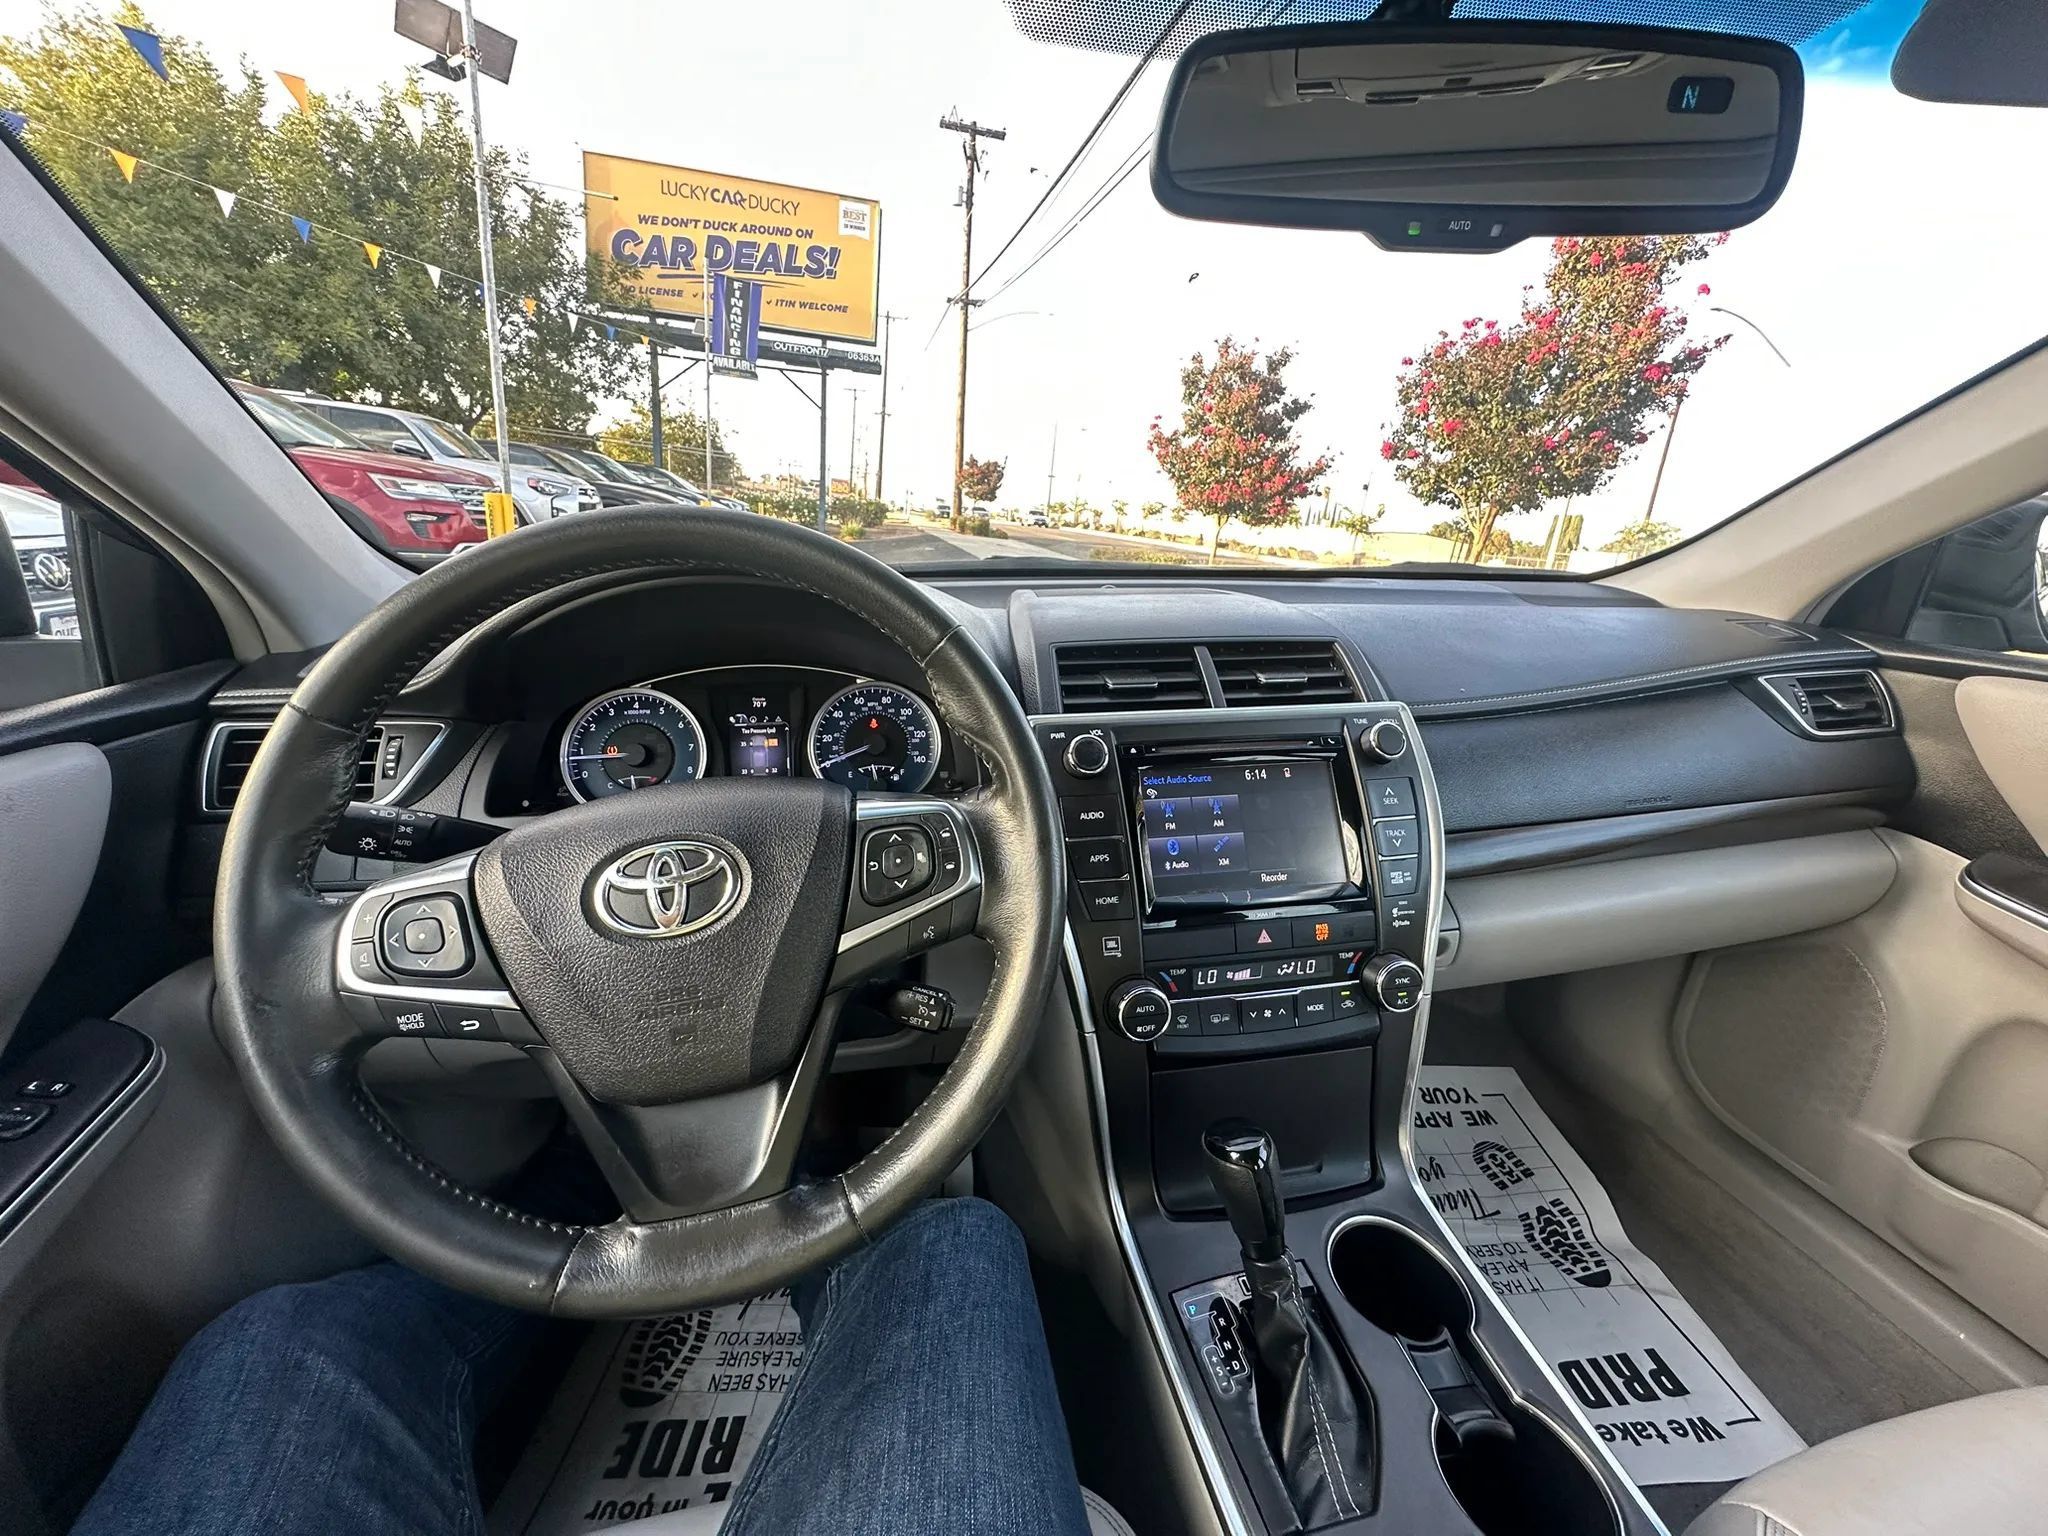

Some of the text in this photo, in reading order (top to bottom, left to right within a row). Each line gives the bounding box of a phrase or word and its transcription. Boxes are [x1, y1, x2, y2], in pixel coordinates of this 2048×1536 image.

[1681, 83, 1700, 109] N
[842, 209, 867, 222] BEST
[638, 214, 814, 240] WE DON'T DUCK AROUND ON
[1448, 220, 1472, 232] AUTO
[611, 228, 842, 279] CAR DEALS!
[638, 285, 685, 298] LICENSE
[774, 298, 850, 314] ITIN WELCOME
[728, 280, 745, 356] FINANCING
[633, 701, 640, 709] 4
[854, 696, 865, 705] 60
[881, 696, 892, 704] 80
[659, 706, 665, 714] 5
[832, 710, 844, 718] 40
[900, 708, 912, 716] 100
[678, 721, 684, 729] 6
[580, 748, 584, 756] 1
[913, 756, 926, 764] 140
[1244, 768, 1267, 781] 6:14
[1143, 774, 1212, 786] Select Audio Source
[1080, 811, 1105, 820] AUDIO
[1165, 822, 1176, 830] FM
[1385, 829, 1406, 837] TRACK
[394, 838, 412, 847] AUTO
[1090, 854, 1110, 863] APPS
[1218, 858, 1230, 866] XM
[1172, 861, 1190, 869] Audio
[1260, 872, 1288, 882] Reorder
[1096, 896, 1120, 905] HOME
[1394, 976, 1410, 984] SYNC
[912, 986, 937, 996] CANCEL
[1136, 1004, 1156, 1013] AUTO
[1306, 1003, 1325, 1012] MODE
[396, 1012, 424, 1024] MODE
[910, 1016, 922, 1025] SET
[405, 1021, 425, 1030] HOLD
[1142, 1024, 1156, 1032] OFF
[28, 1081, 38, 1090] L
[50, 1083, 63, 1091] R
[1418, 1087, 1479, 1104] YOUR
[1460, 1110, 1498, 1127] WE
[1503, 1242, 1528, 1256] TO
[1519, 1258, 1530, 1272] A
[1491, 1276, 1545, 1295] IT HAS
[1189, 1305, 1196, 1314] P
[1218, 1318, 1226, 1326] R
[714, 1331, 750, 1346] YOU
[1223, 1340, 1232, 1351] N
[716, 1350, 804, 1368] PLEASURE
[1232, 1360, 1240, 1370] D
[1216, 1366, 1224, 1376] S
[708, 1373, 793, 1392] HAS BEEN
[1558, 1348, 1692, 1410] PRID
[1595, 1416, 1727, 1446] We take
[602, 1416, 747, 1480] RIDE
[584, 1493, 655, 1520] your
